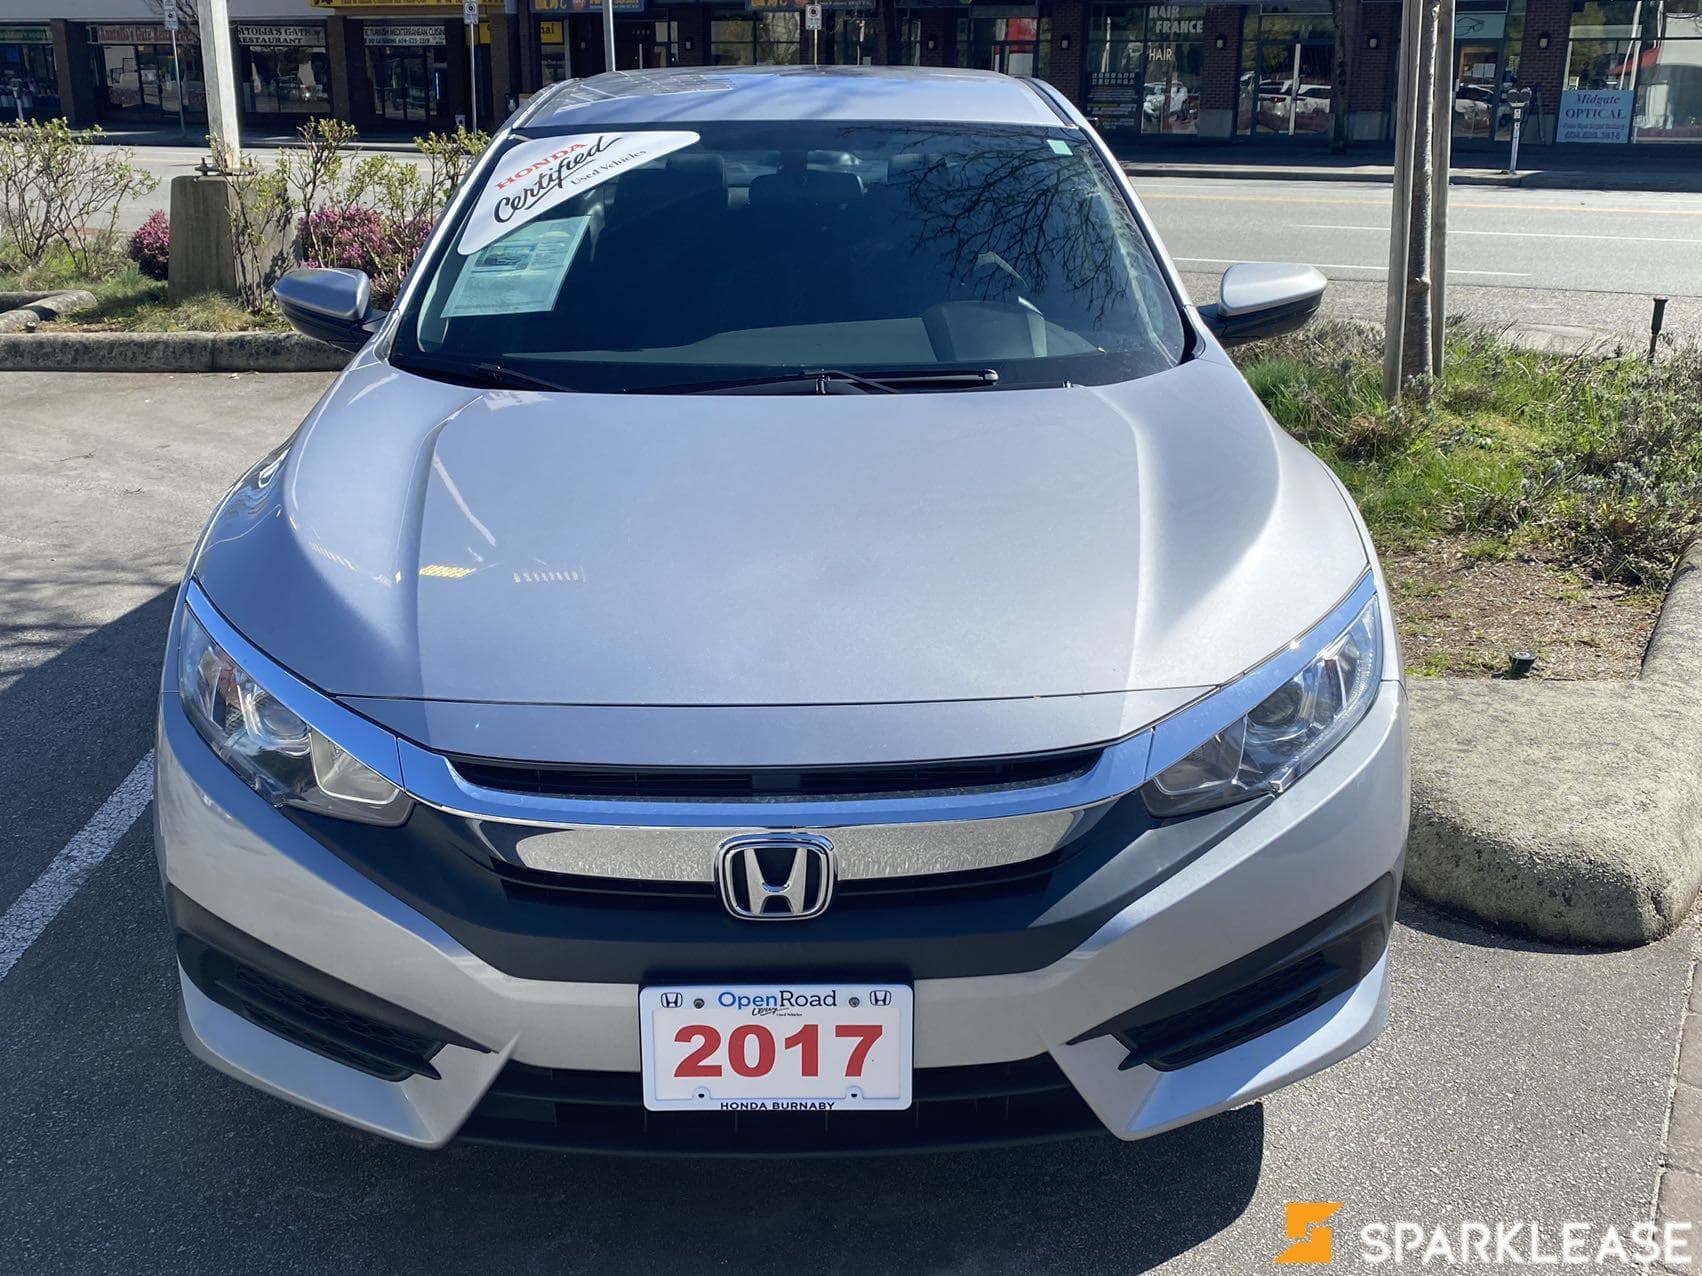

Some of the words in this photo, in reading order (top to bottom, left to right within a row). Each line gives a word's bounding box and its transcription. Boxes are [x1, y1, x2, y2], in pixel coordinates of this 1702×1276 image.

[1149, 6, 1180, 18] HAIR
[1155, 21, 1203, 33] FRANCE
[1149, 49, 1173, 60] HAIR
[1577, 94, 1621, 105] Midgate
[1565, 108, 1626, 119] OPTICAL
[496, 143, 588, 190] HONDA
[570, 167, 600, 186] Used
[601, 150, 647, 172] Vehicles
[493, 135, 623, 224] Certified
[718, 990, 837, 1010] OpenRoad
[673, 1023, 884, 1078] 2017
[720, 1101, 766, 1111] HONDA
[772, 1101, 835, 1111] BURNABY
